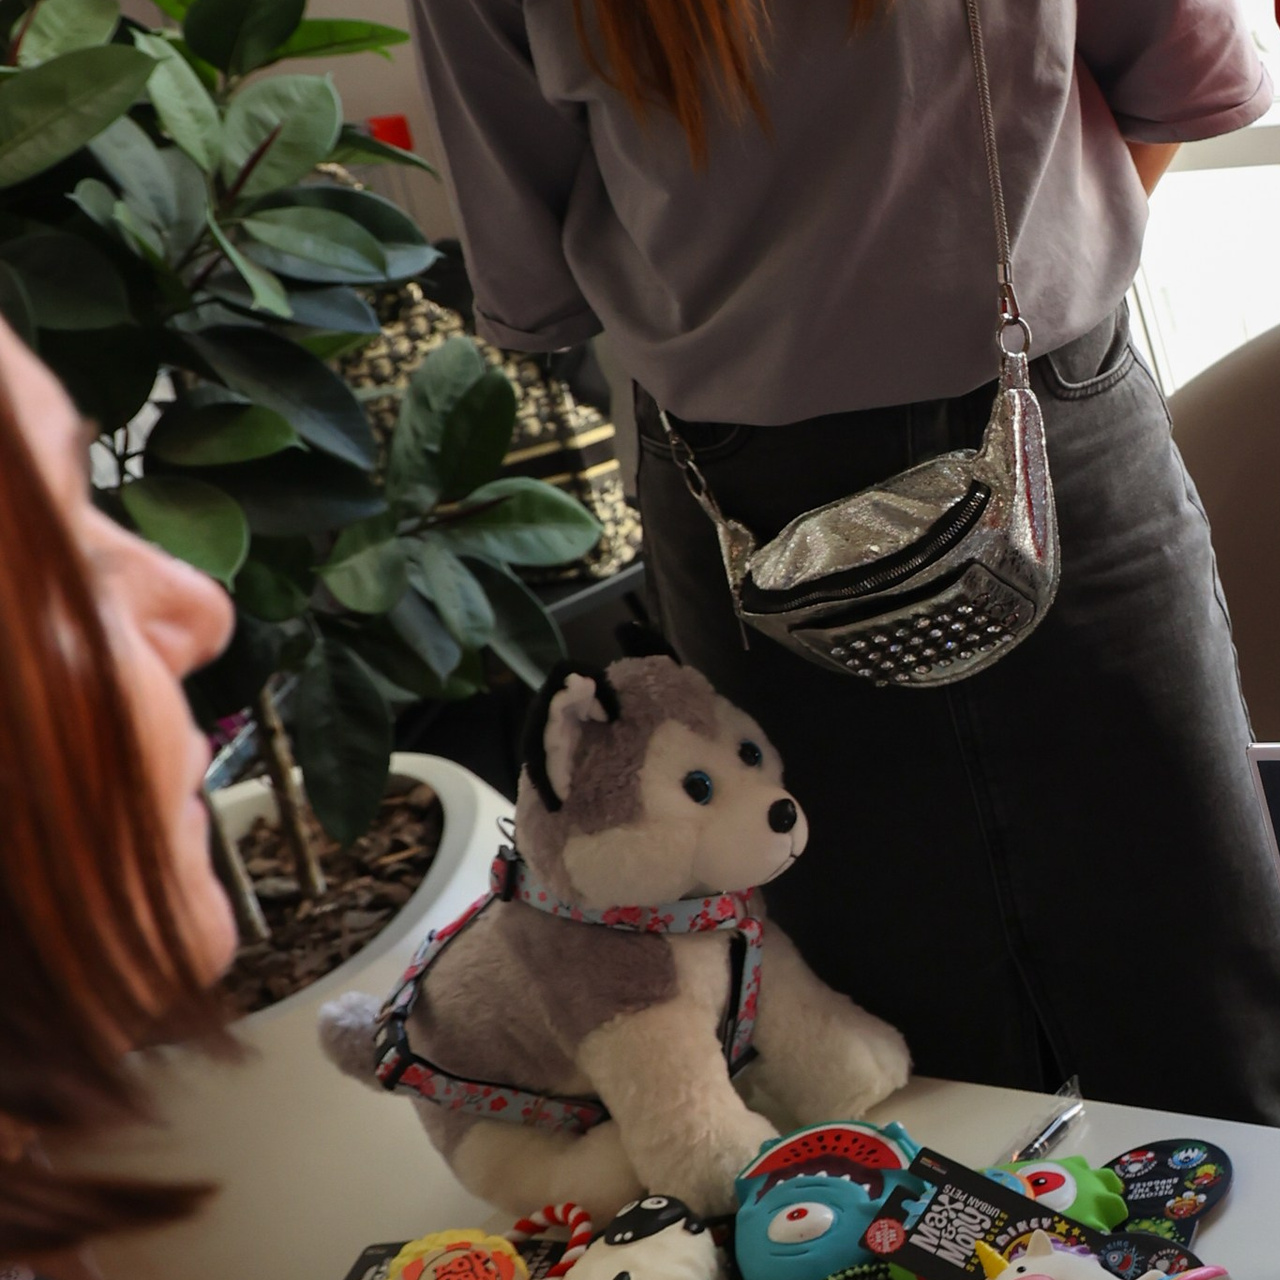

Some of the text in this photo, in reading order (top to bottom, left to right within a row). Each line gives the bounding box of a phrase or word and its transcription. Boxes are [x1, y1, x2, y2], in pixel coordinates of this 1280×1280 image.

[909, 1193, 965, 1253] Max
[942, 1183, 1001, 1220] URBAN PETS
[936, 1206, 992, 1269] Molly
[942, 1226, 957, 1240] &
